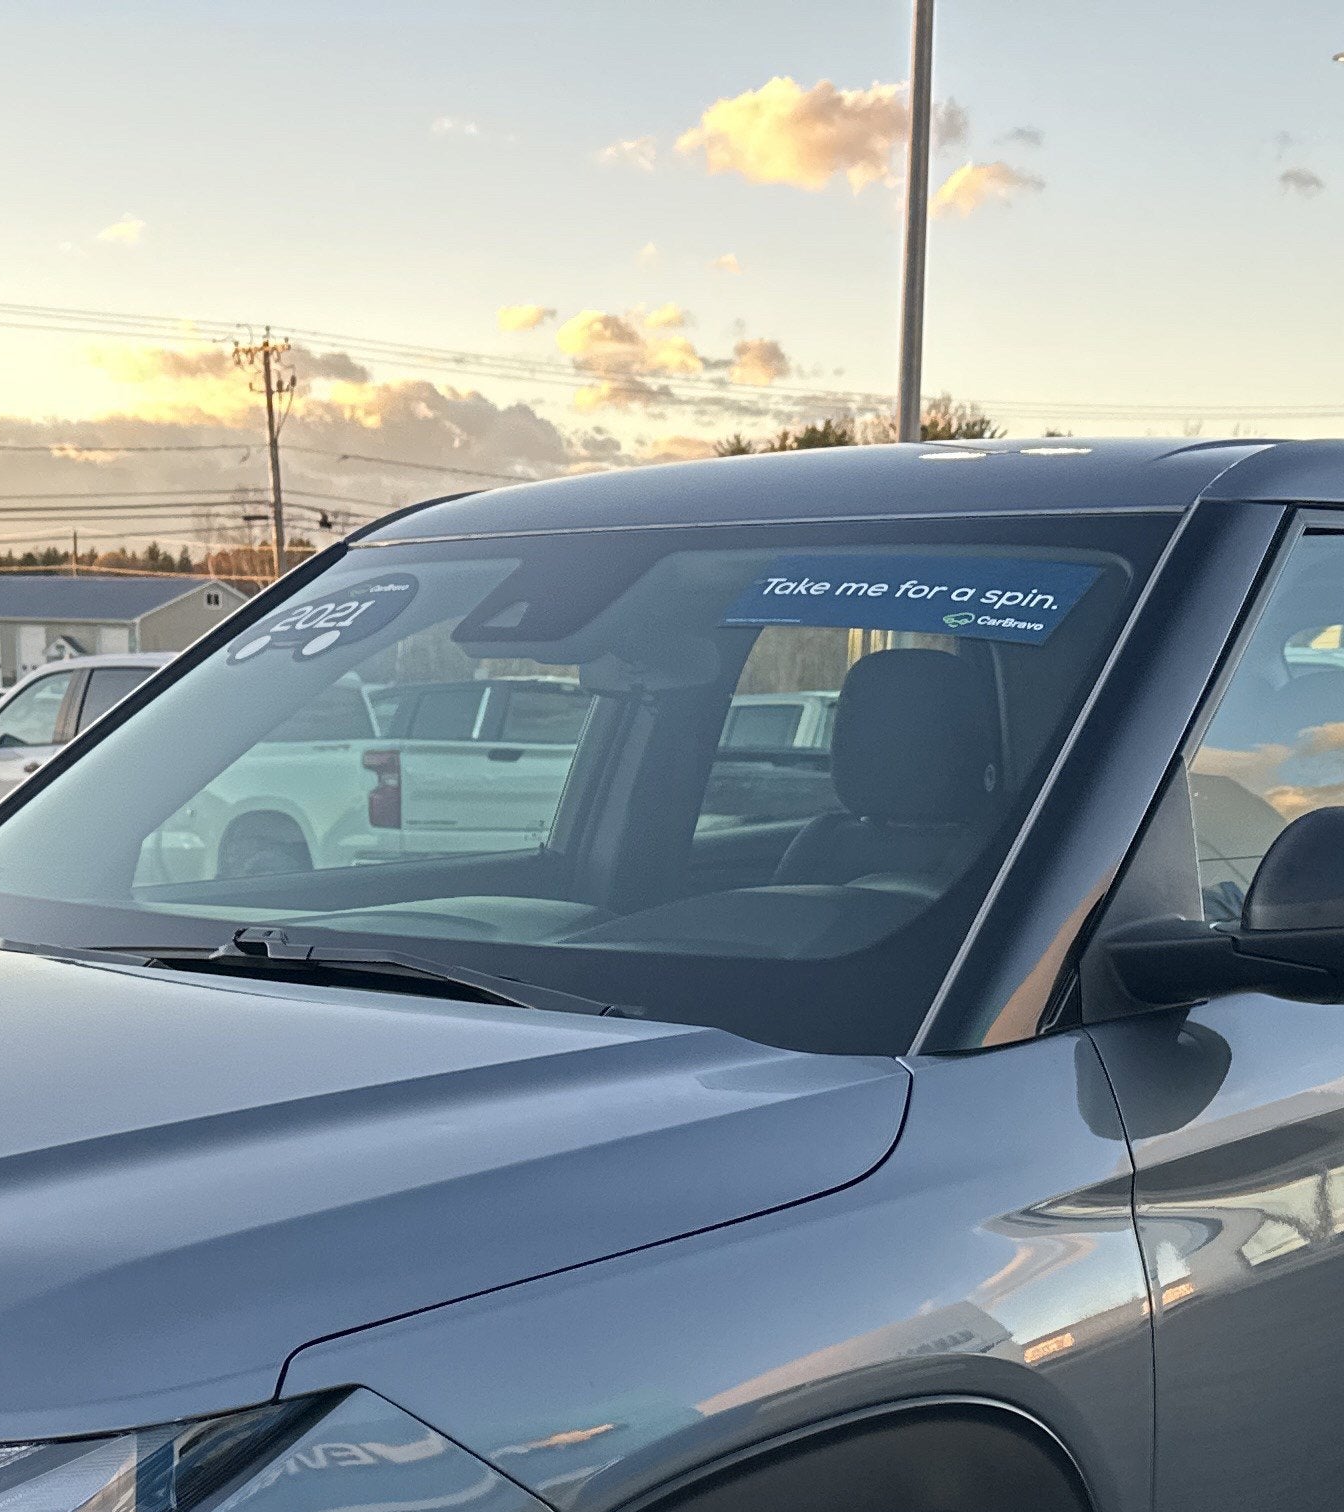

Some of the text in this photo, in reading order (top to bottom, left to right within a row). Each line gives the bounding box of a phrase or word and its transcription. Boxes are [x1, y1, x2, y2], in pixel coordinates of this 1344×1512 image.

[762, 577, 1060, 611] Take me for a spin.
[269, 599, 376, 633] 2021
[976, 614, 1045, 632] CarBravo
